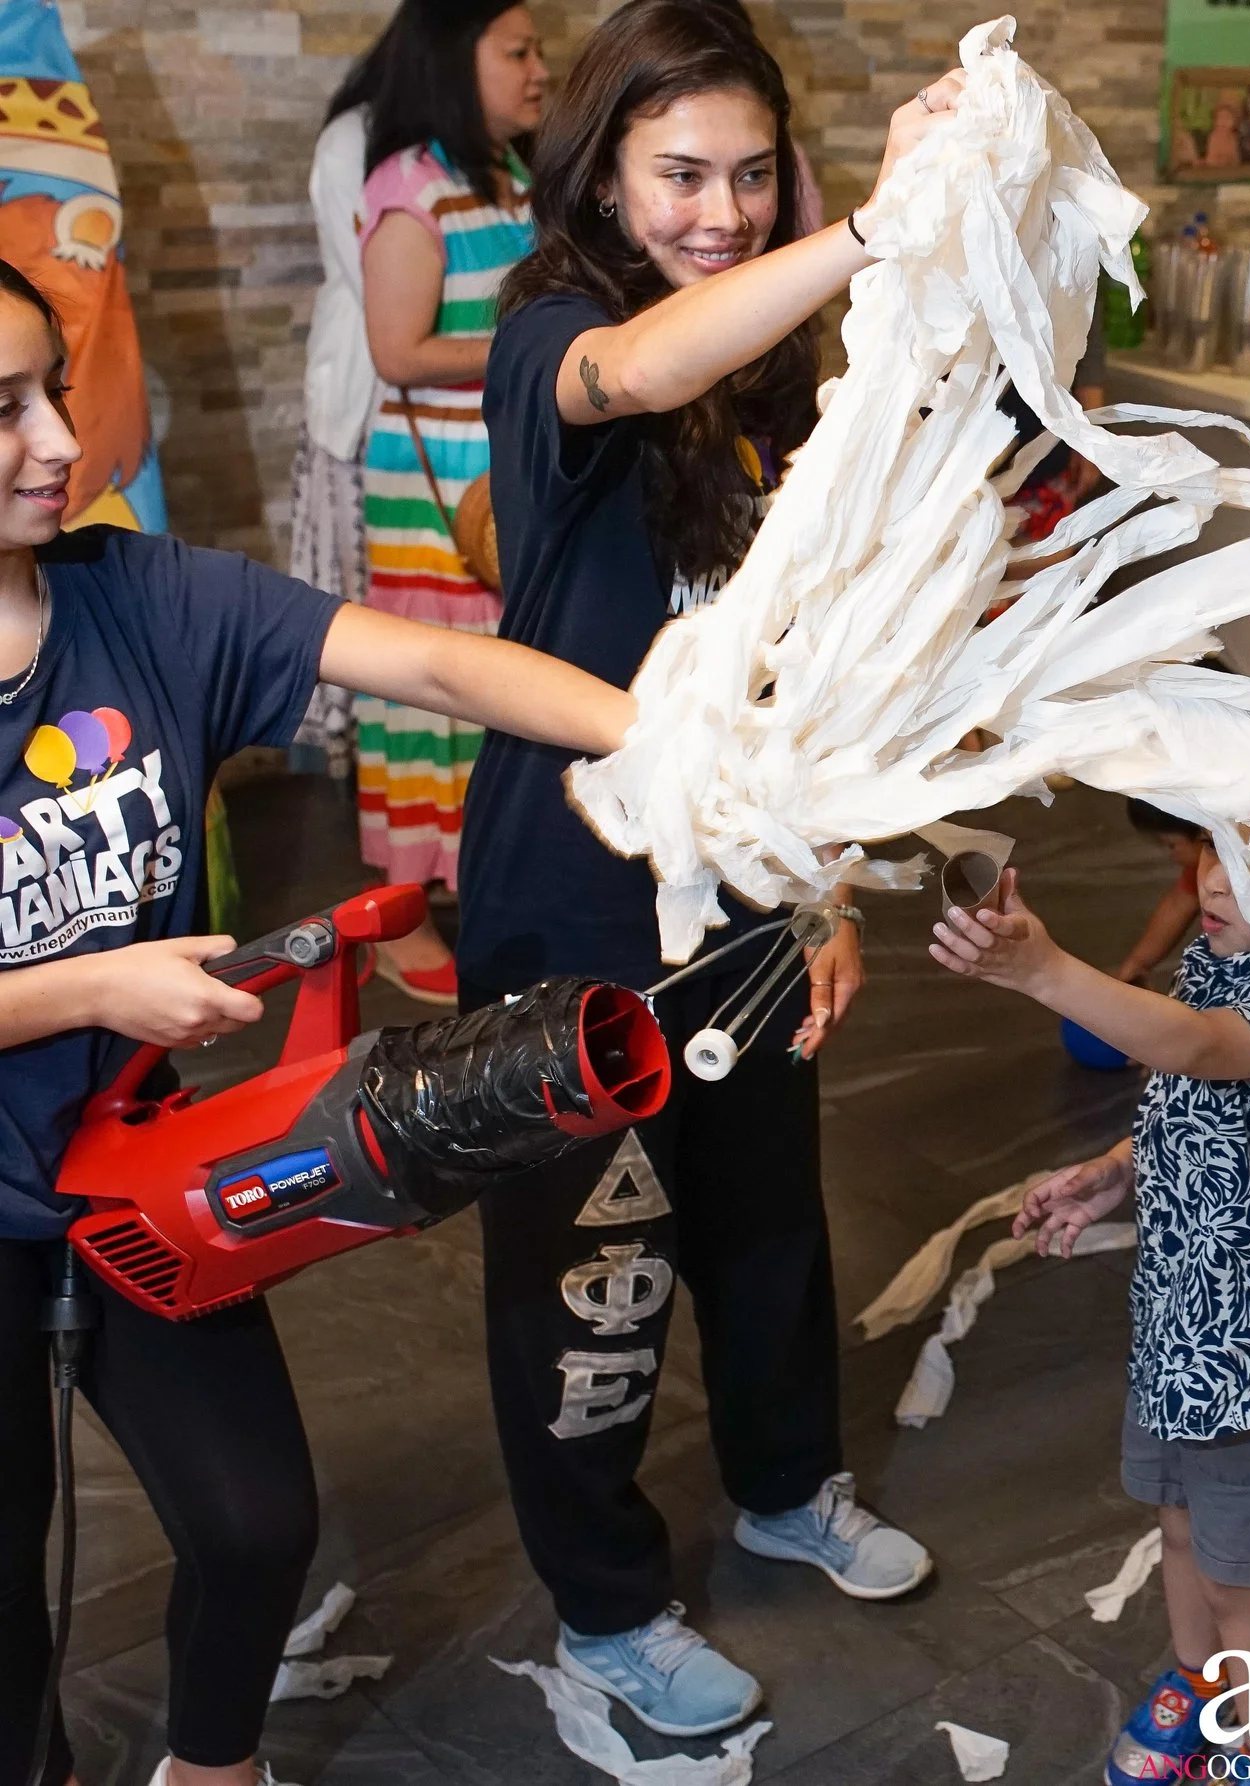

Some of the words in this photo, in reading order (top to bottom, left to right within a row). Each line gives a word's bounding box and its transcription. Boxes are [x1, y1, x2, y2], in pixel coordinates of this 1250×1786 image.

[0, 749, 171, 894] ARTY
[269, 1165, 327, 1193] POWERJET
[302, 1177, 326, 1190] F700
